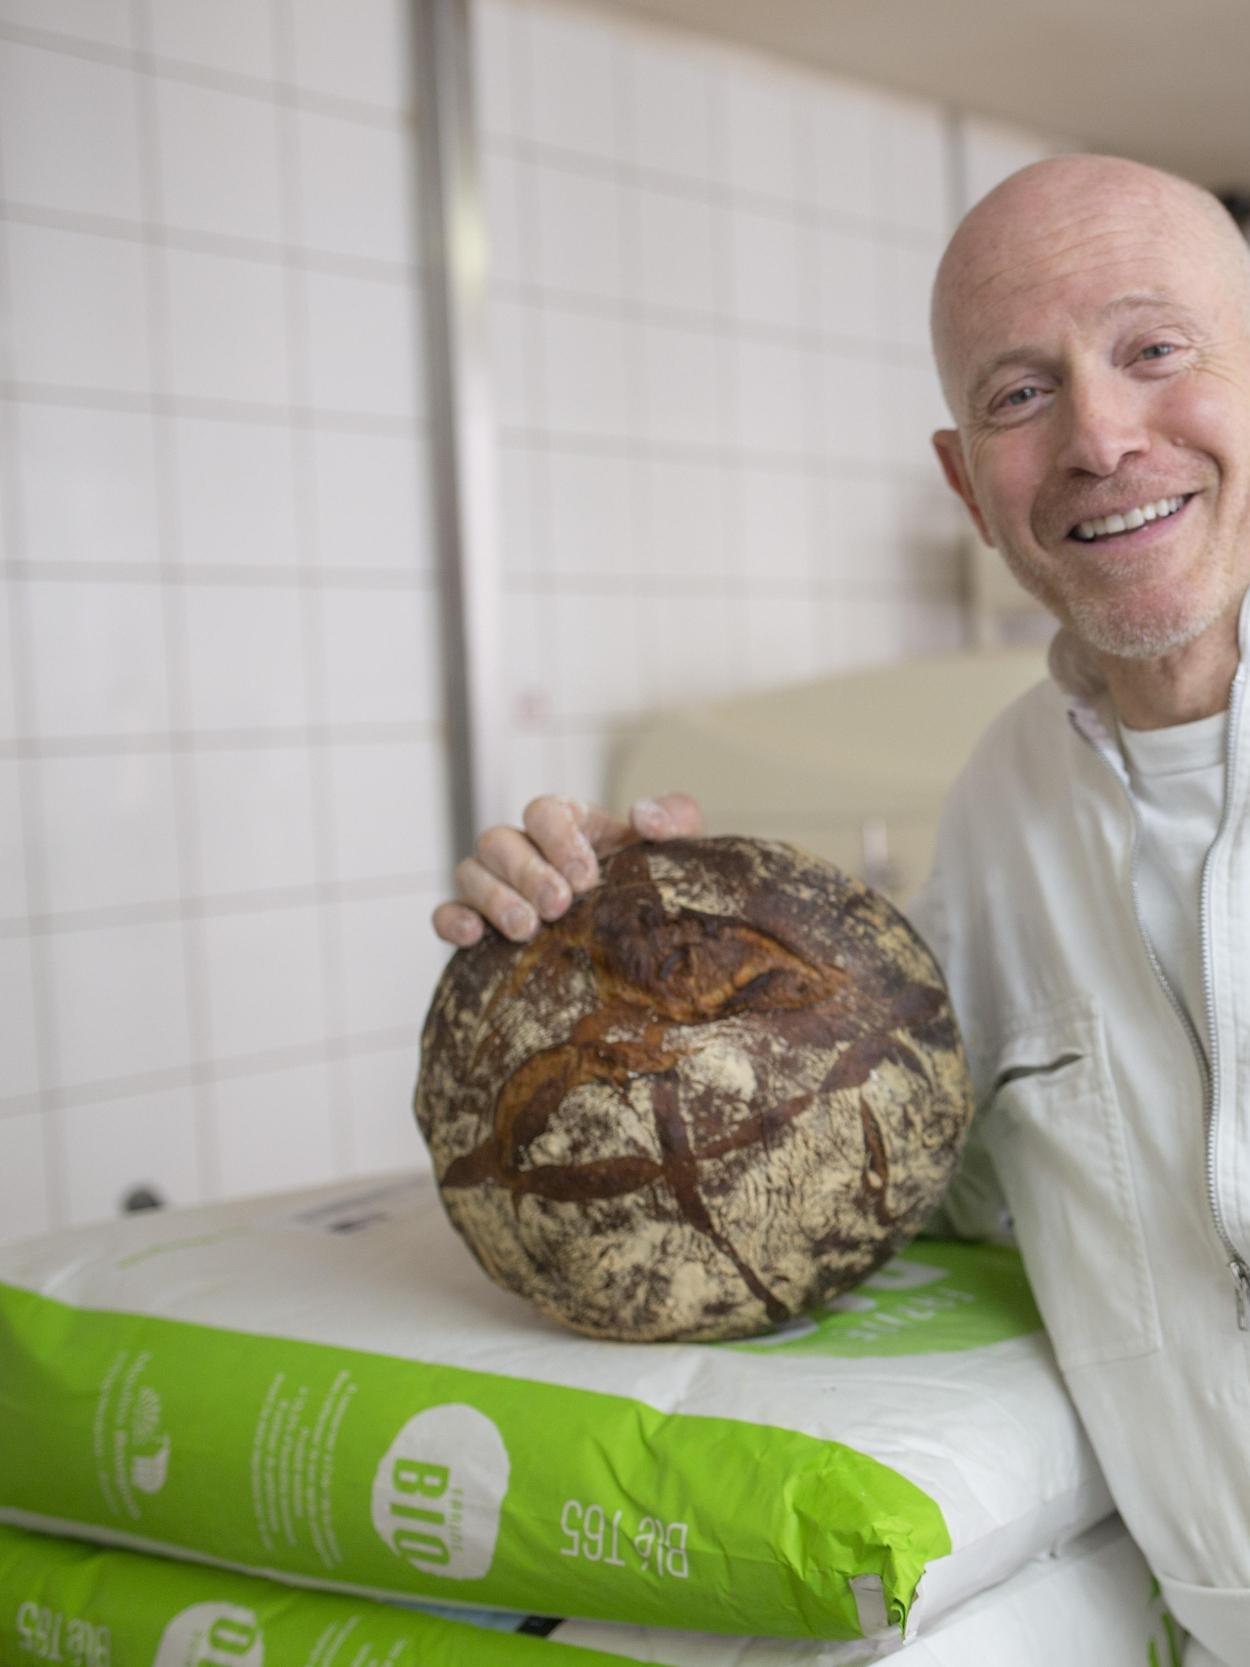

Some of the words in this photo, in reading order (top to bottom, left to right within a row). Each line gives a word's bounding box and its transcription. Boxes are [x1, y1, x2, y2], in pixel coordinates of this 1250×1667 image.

[389, 1458, 450, 1566] BIO
[560, 1500, 625, 1566] T65
[635, 1517, 689, 1579] Blé
